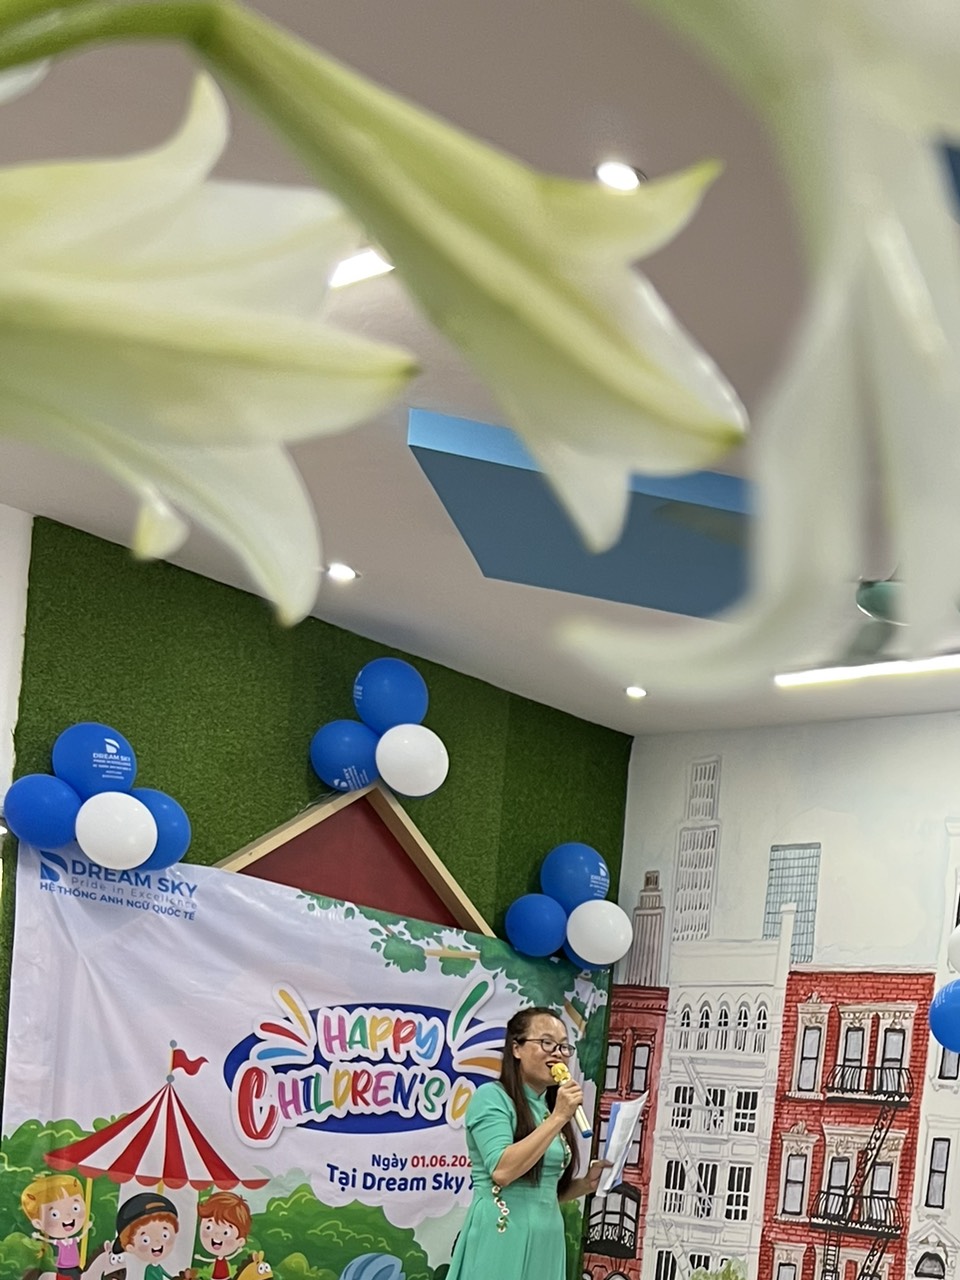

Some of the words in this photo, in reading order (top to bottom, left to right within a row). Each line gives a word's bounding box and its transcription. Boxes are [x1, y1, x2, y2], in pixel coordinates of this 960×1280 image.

[71, 859, 151, 889] DREAM
[157, 877, 198, 898] SKY
[71, 876, 106, 891] Pride
[112, 886, 124, 895] in
[131, 889, 198, 909] Excellence
[57, 885, 97, 901] THỐNG
[99, 893, 123, 906] ANH
[126, 897, 150, 911] NGỮ
[152, 904, 181, 918] QUỐC
[183, 908, 195, 921] TẾ
[323, 1014, 439, 1060] HAPPY
[237, 1066, 446, 1140] CHILDREN'S
[450, 1083, 473, 1121] D
[326, 1163, 357, 1192] Tại
[362, 1172, 427, 1192] Dream
[431, 1171, 465, 1195] Sky
[371, 1152, 408, 1171] Ngày
[411, 1155, 473, 1168] 01.06.202
